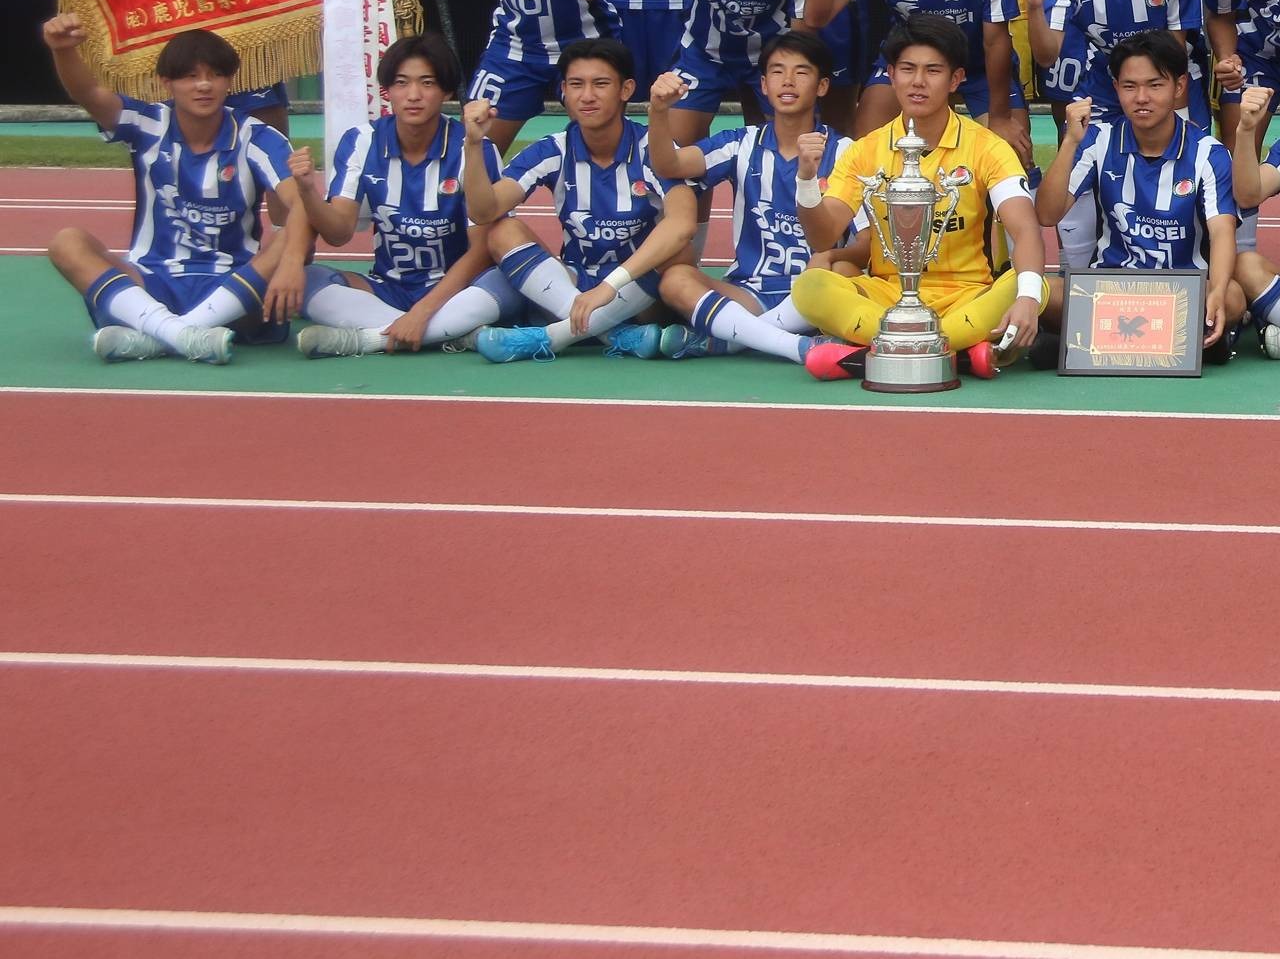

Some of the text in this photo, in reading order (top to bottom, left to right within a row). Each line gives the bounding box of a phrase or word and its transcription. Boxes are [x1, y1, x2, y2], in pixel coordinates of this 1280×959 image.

[1045, 56, 1082, 93] 30
[469, 69, 506, 107] 16
[180, 207, 236, 226] JOSEI
[402, 215, 450, 226] KAGOSHIMA
[594, 218, 642, 230] KAGOSHIMA
[1135, 214, 1180, 227] KAGOSHIMA
[396, 222, 457, 240] JOSEI
[1129, 223, 1187, 242] JOSEI
[390, 242, 437, 272] 20
[762, 242, 808, 276] 26
